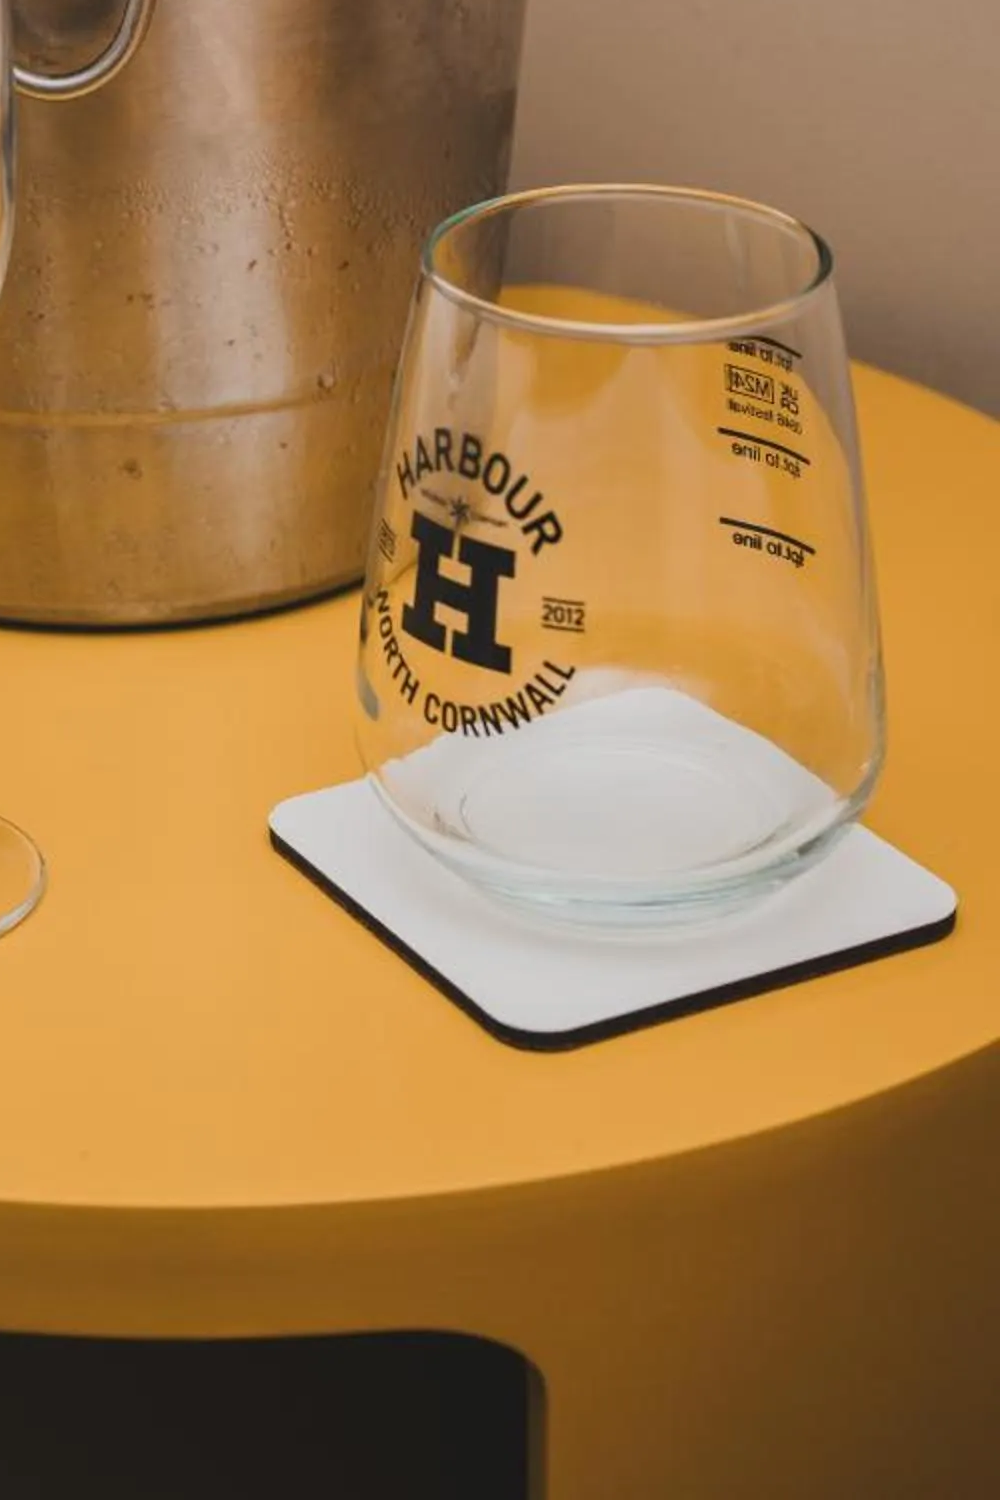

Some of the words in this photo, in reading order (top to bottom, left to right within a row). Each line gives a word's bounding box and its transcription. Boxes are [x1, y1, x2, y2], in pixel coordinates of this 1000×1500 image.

[397, 427, 563, 555] HARBOUR
[376, 584, 420, 704] NORTH
[424, 660, 576, 737] CORNWALL
[401, 510, 516, 674] H
[542, 604, 585, 626] 2012
